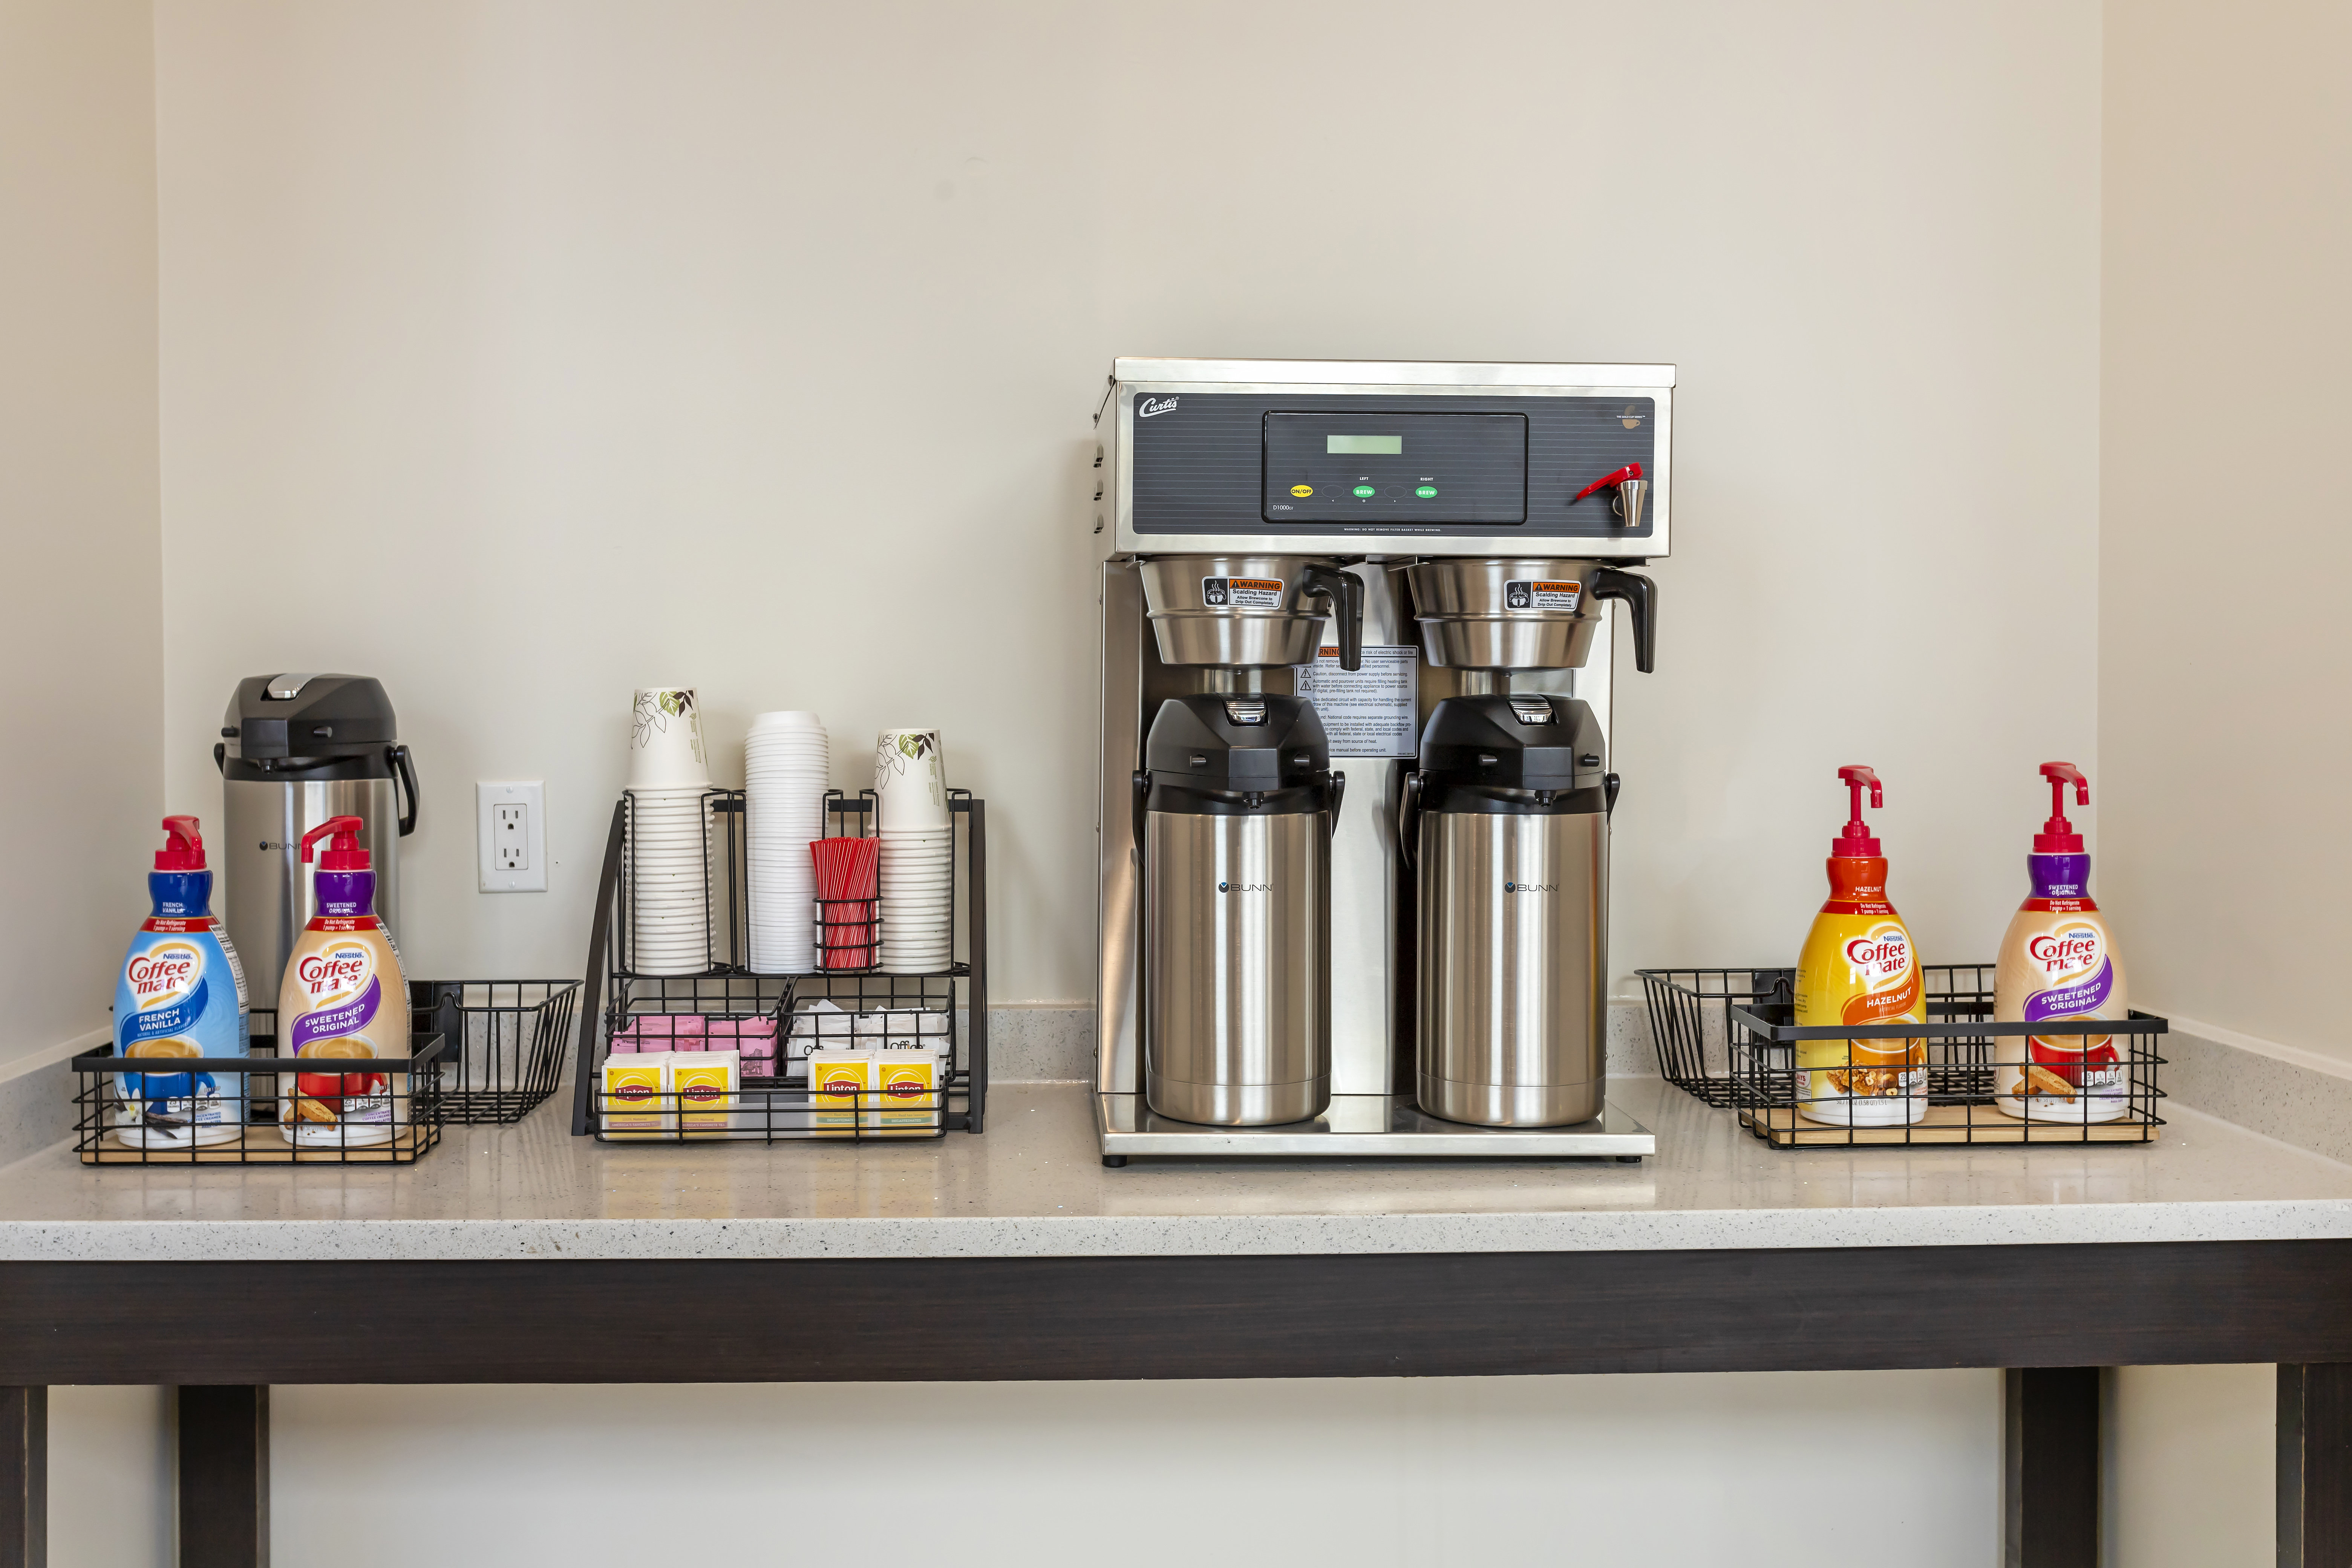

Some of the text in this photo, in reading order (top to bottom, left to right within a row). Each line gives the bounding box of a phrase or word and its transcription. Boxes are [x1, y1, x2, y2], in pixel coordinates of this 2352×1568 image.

[1139, 398, 1177, 417] Curtis
[1240, 581, 1280, 590] WARNING
[1847, 940, 1905, 964] Coffee
[2030, 936, 2095, 960] Coffee
[129, 957, 190, 982] Coffee
[300, 956, 362, 982] Coffee
[2046, 954, 2092, 972] mae
[311, 975, 357, 994] mae
[2042, 982, 2101, 1004] SWEETENED
[1867, 986, 1911, 1008] HAZELNUT
[2050, 995, 2096, 1011] ORIGINAL
[139, 1008, 179, 1023] FRENCH
[140, 1017, 181, 1031] VANILLA
[305, 1004, 365, 1027] SWEETENED
[313, 1017, 359, 1033] ORIGINAL
[687, 1089, 717, 1099] Lipton
